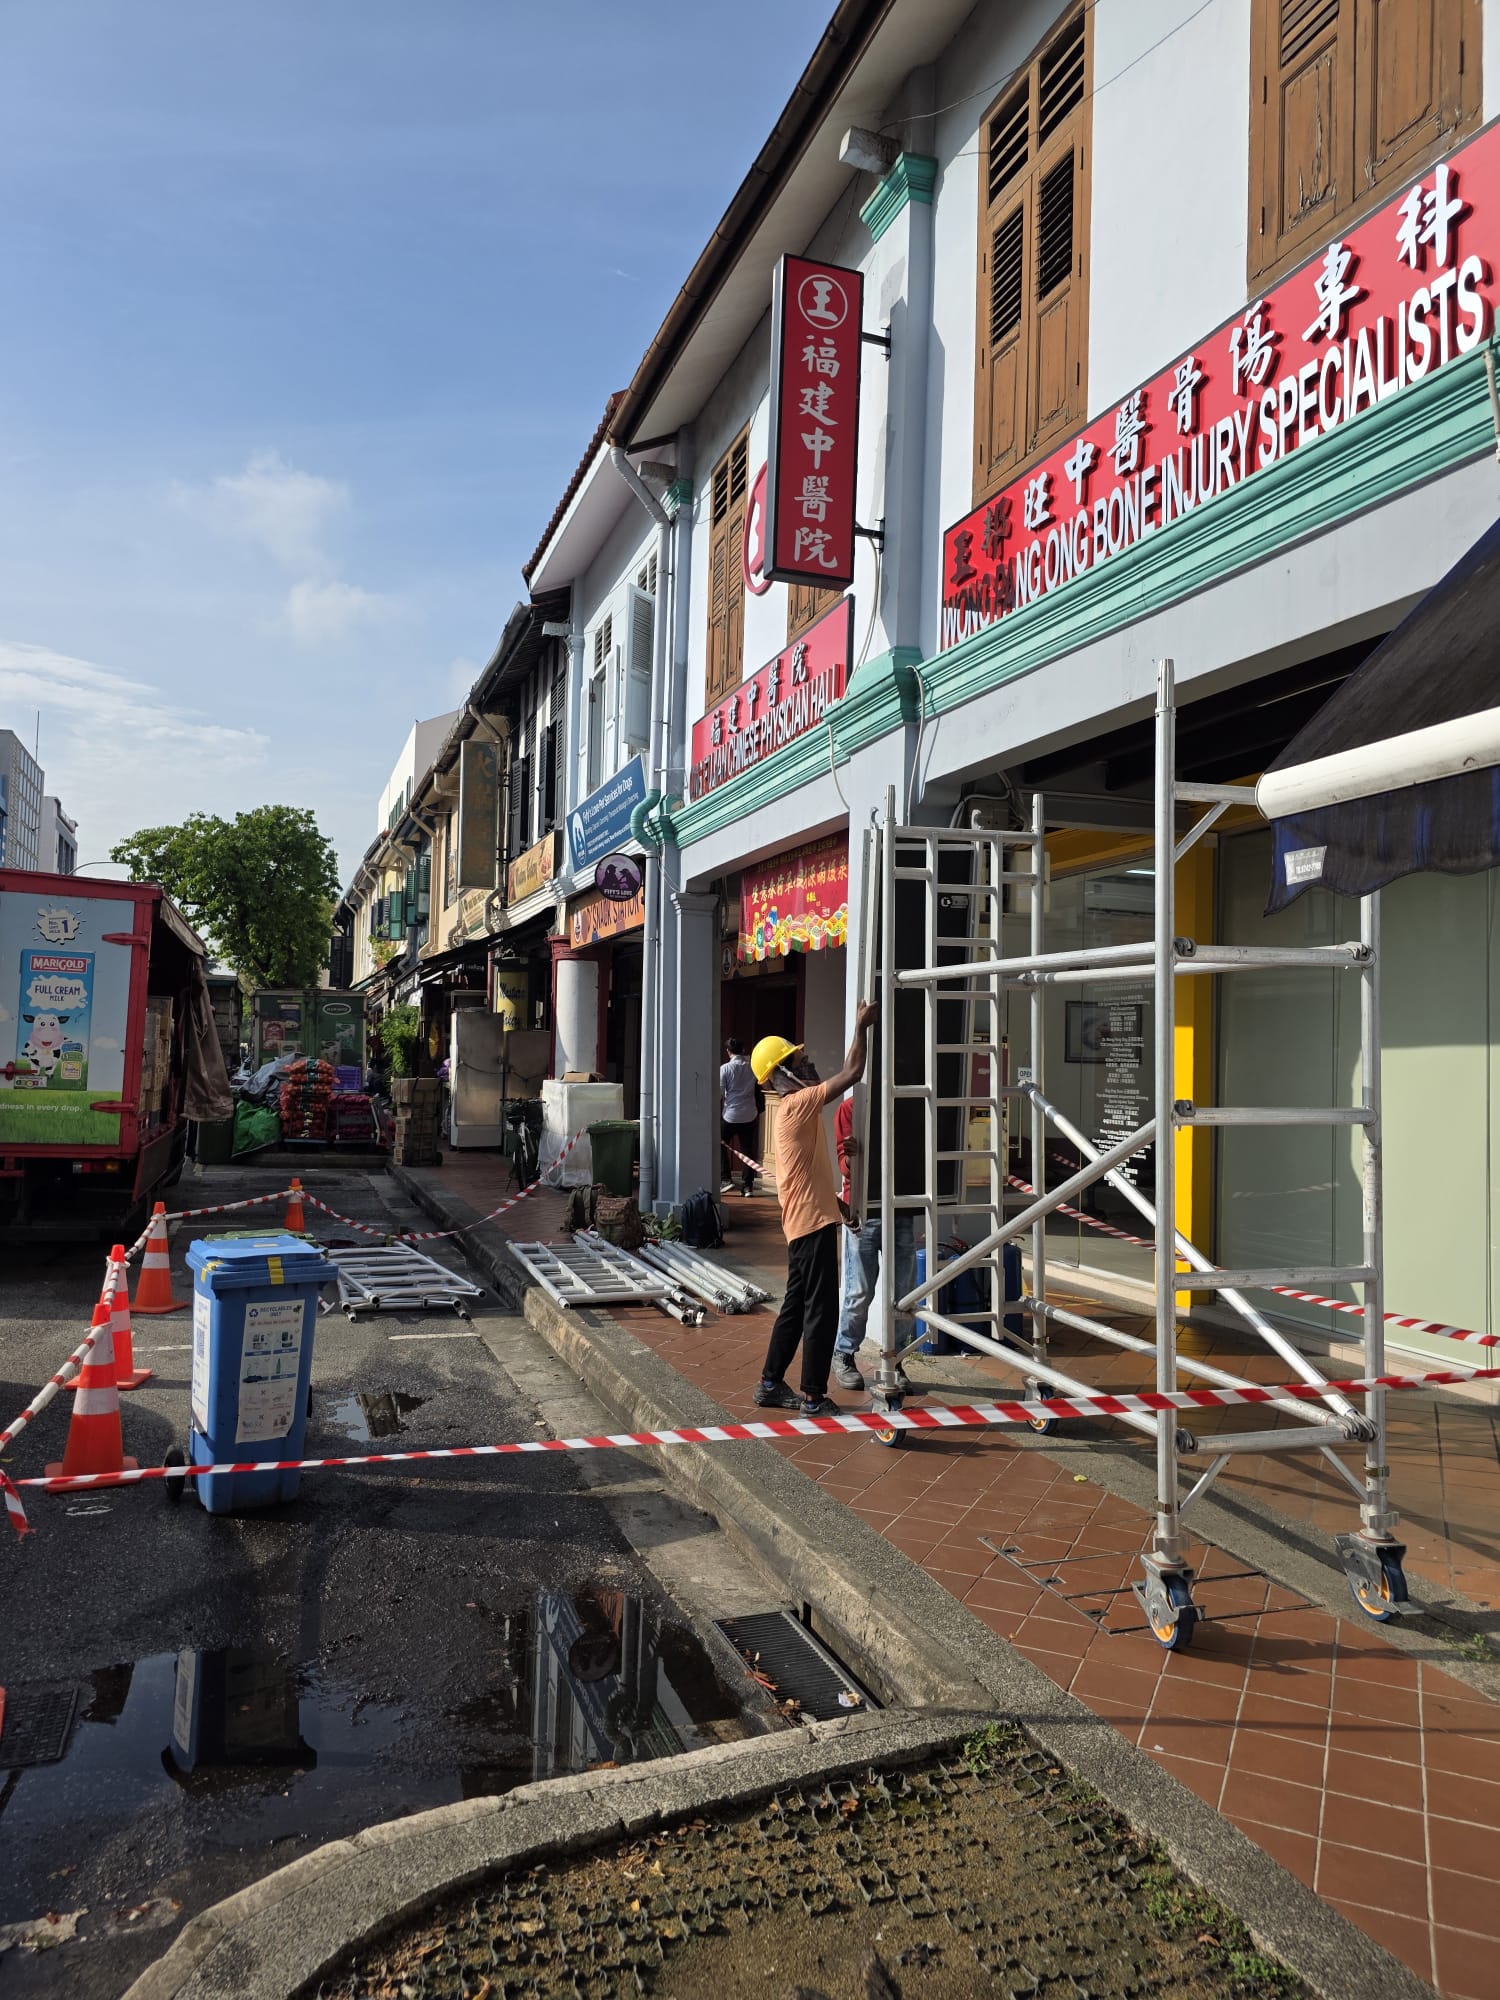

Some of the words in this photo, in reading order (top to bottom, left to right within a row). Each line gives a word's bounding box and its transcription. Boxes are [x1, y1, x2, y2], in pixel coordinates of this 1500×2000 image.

[806, 280, 839, 323] 王
[793, 335, 841, 569] 福建中醫院
[943, 573, 991, 652] WONG
[1045, 508, 1089, 593] ONG
[1093, 463, 1155, 562] BONE
[1161, 400, 1254, 526] INJURY
[1257, 254, 1485, 469] SPECIALISTS
[711, 641, 809, 750] 福建中醫院
[729, 719, 762, 774] CHINESE
[761, 681, 810, 755] PHYSICIAN
[811, 664, 839, 720] HALL
[33, 957, 85, 971] MARIGOLD
[34, 984, 53, 994] FULL
[54, 986, 81, 996] CREAM
[36, 1104, 59, 1113] every
